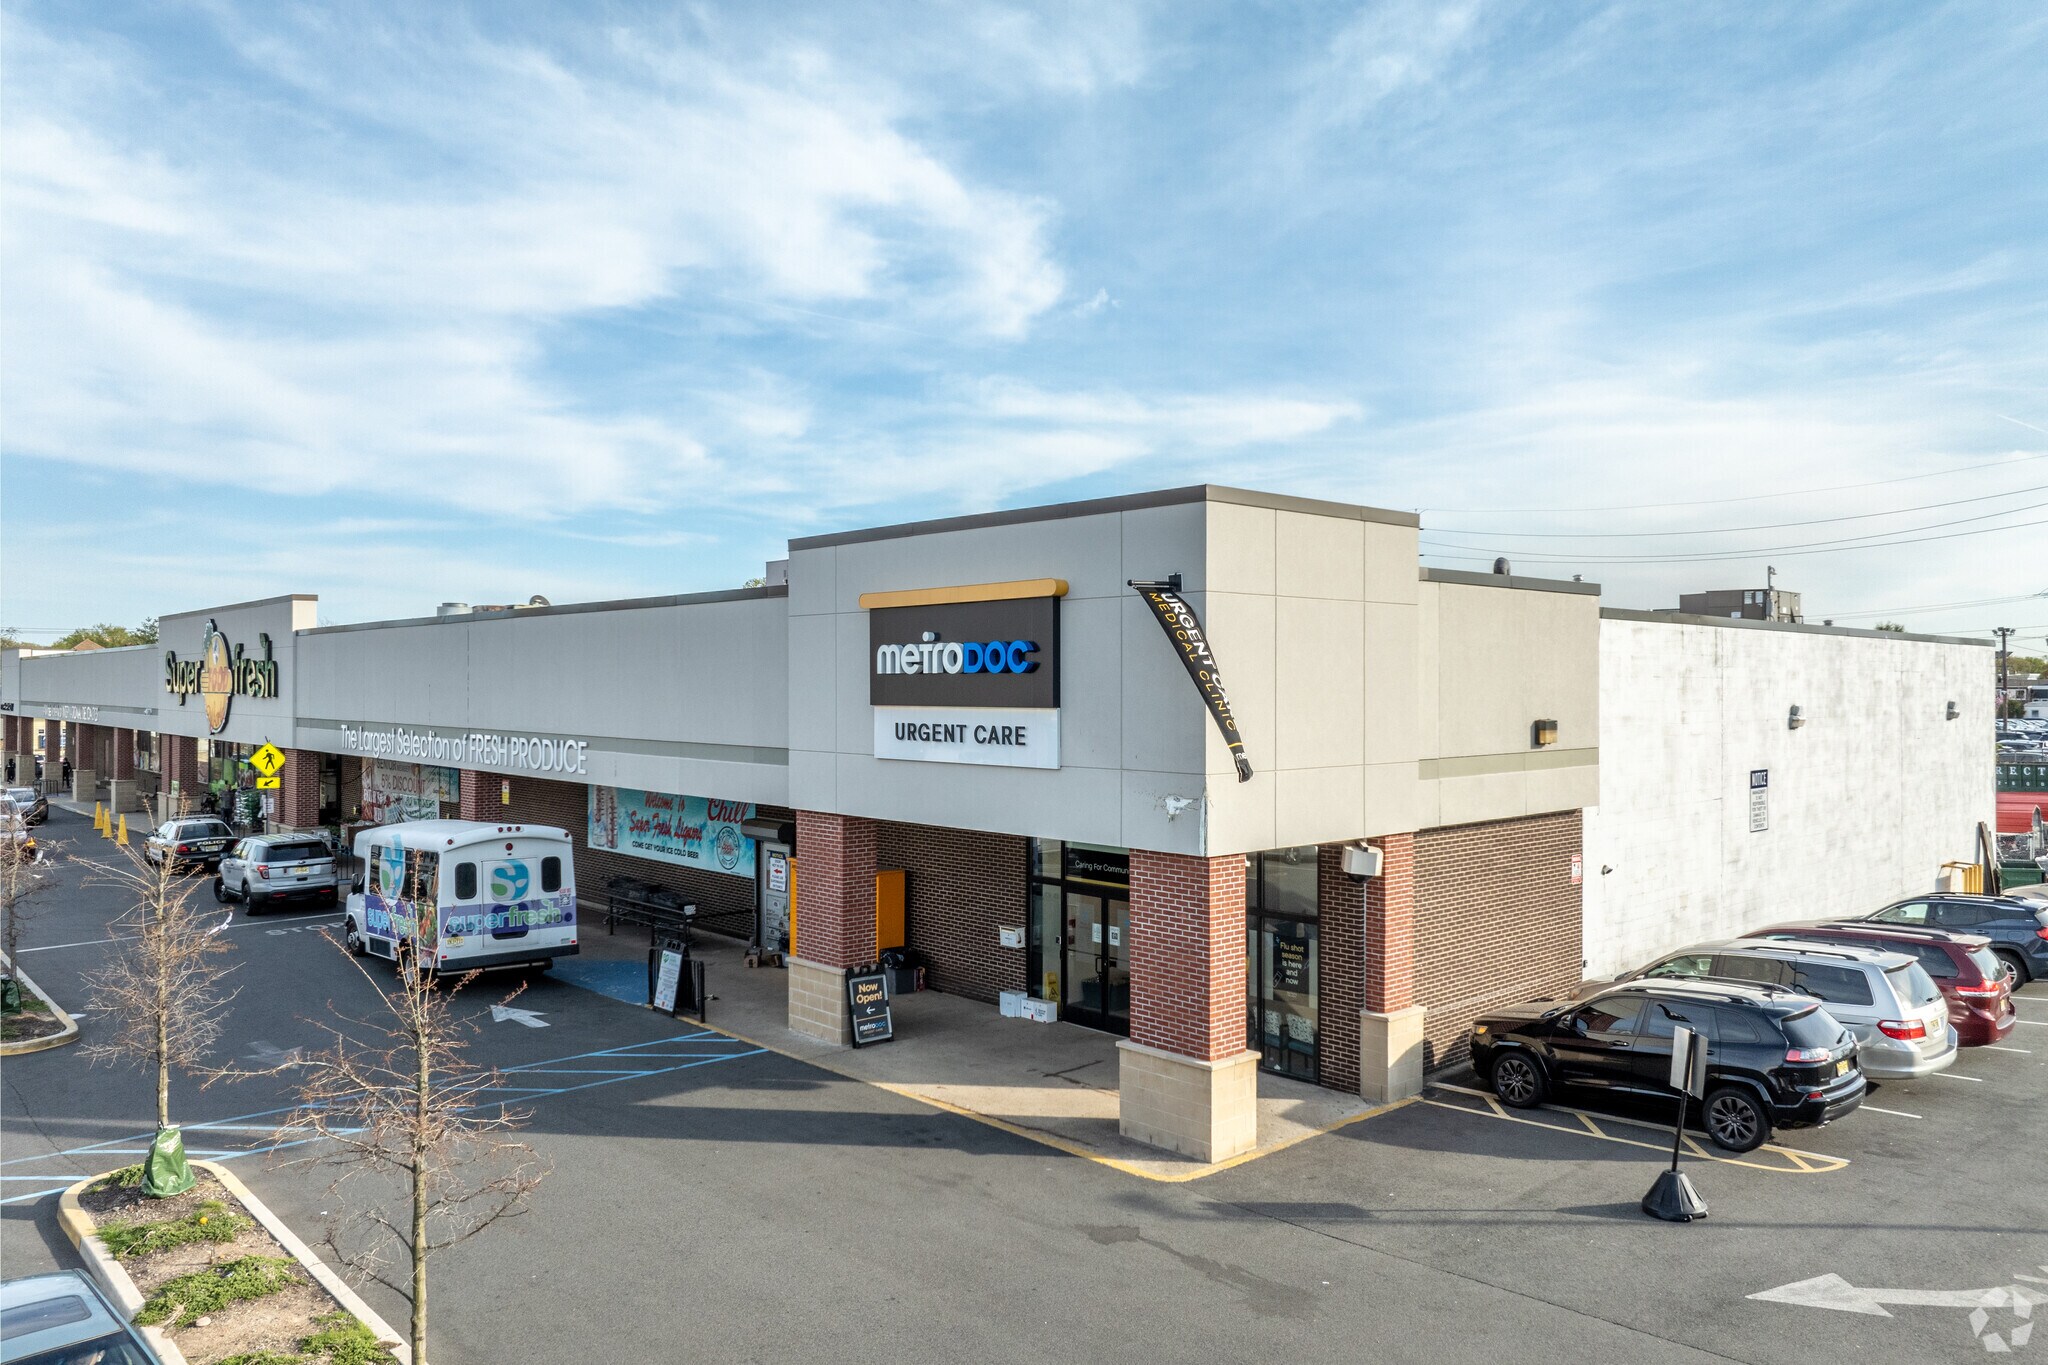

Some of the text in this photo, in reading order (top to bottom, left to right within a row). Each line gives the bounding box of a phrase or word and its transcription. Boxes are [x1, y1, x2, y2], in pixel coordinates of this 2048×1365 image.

[1161, 592, 1216, 670] URGENT
[877, 631, 1037, 675] metroDOC
[1149, 592, 1238, 732] MEDICAL CLINIC
[164, 650, 204, 706] Super
[895, 722, 1027, 746] URGENT CARE
[341, 724, 588, 775] The Largest Selection of FRESH PRODUCE
[381, 774, 391, 789] 5%
[393, 775, 425, 795] DISCOUNT
[707, 798, 749, 824] Chill
[632, 840, 644, 849] COME
[645, 842, 654, 851] GET
[654, 844, 666, 853] YOUR
[674, 848, 686, 857] COLD
[687, 851, 700, 860] BEER
[1075, 860, 1092, 871] Caring
[1280, 942, 1304, 953] Flu shot
[1281, 951, 1303, 961] season
[1282, 958, 1302, 970] is here
[1286, 969, 1298, 977] and
[858, 983, 878, 993] Now
[1285, 977, 1299, 986] now
[856, 990, 883, 1005] Open!
